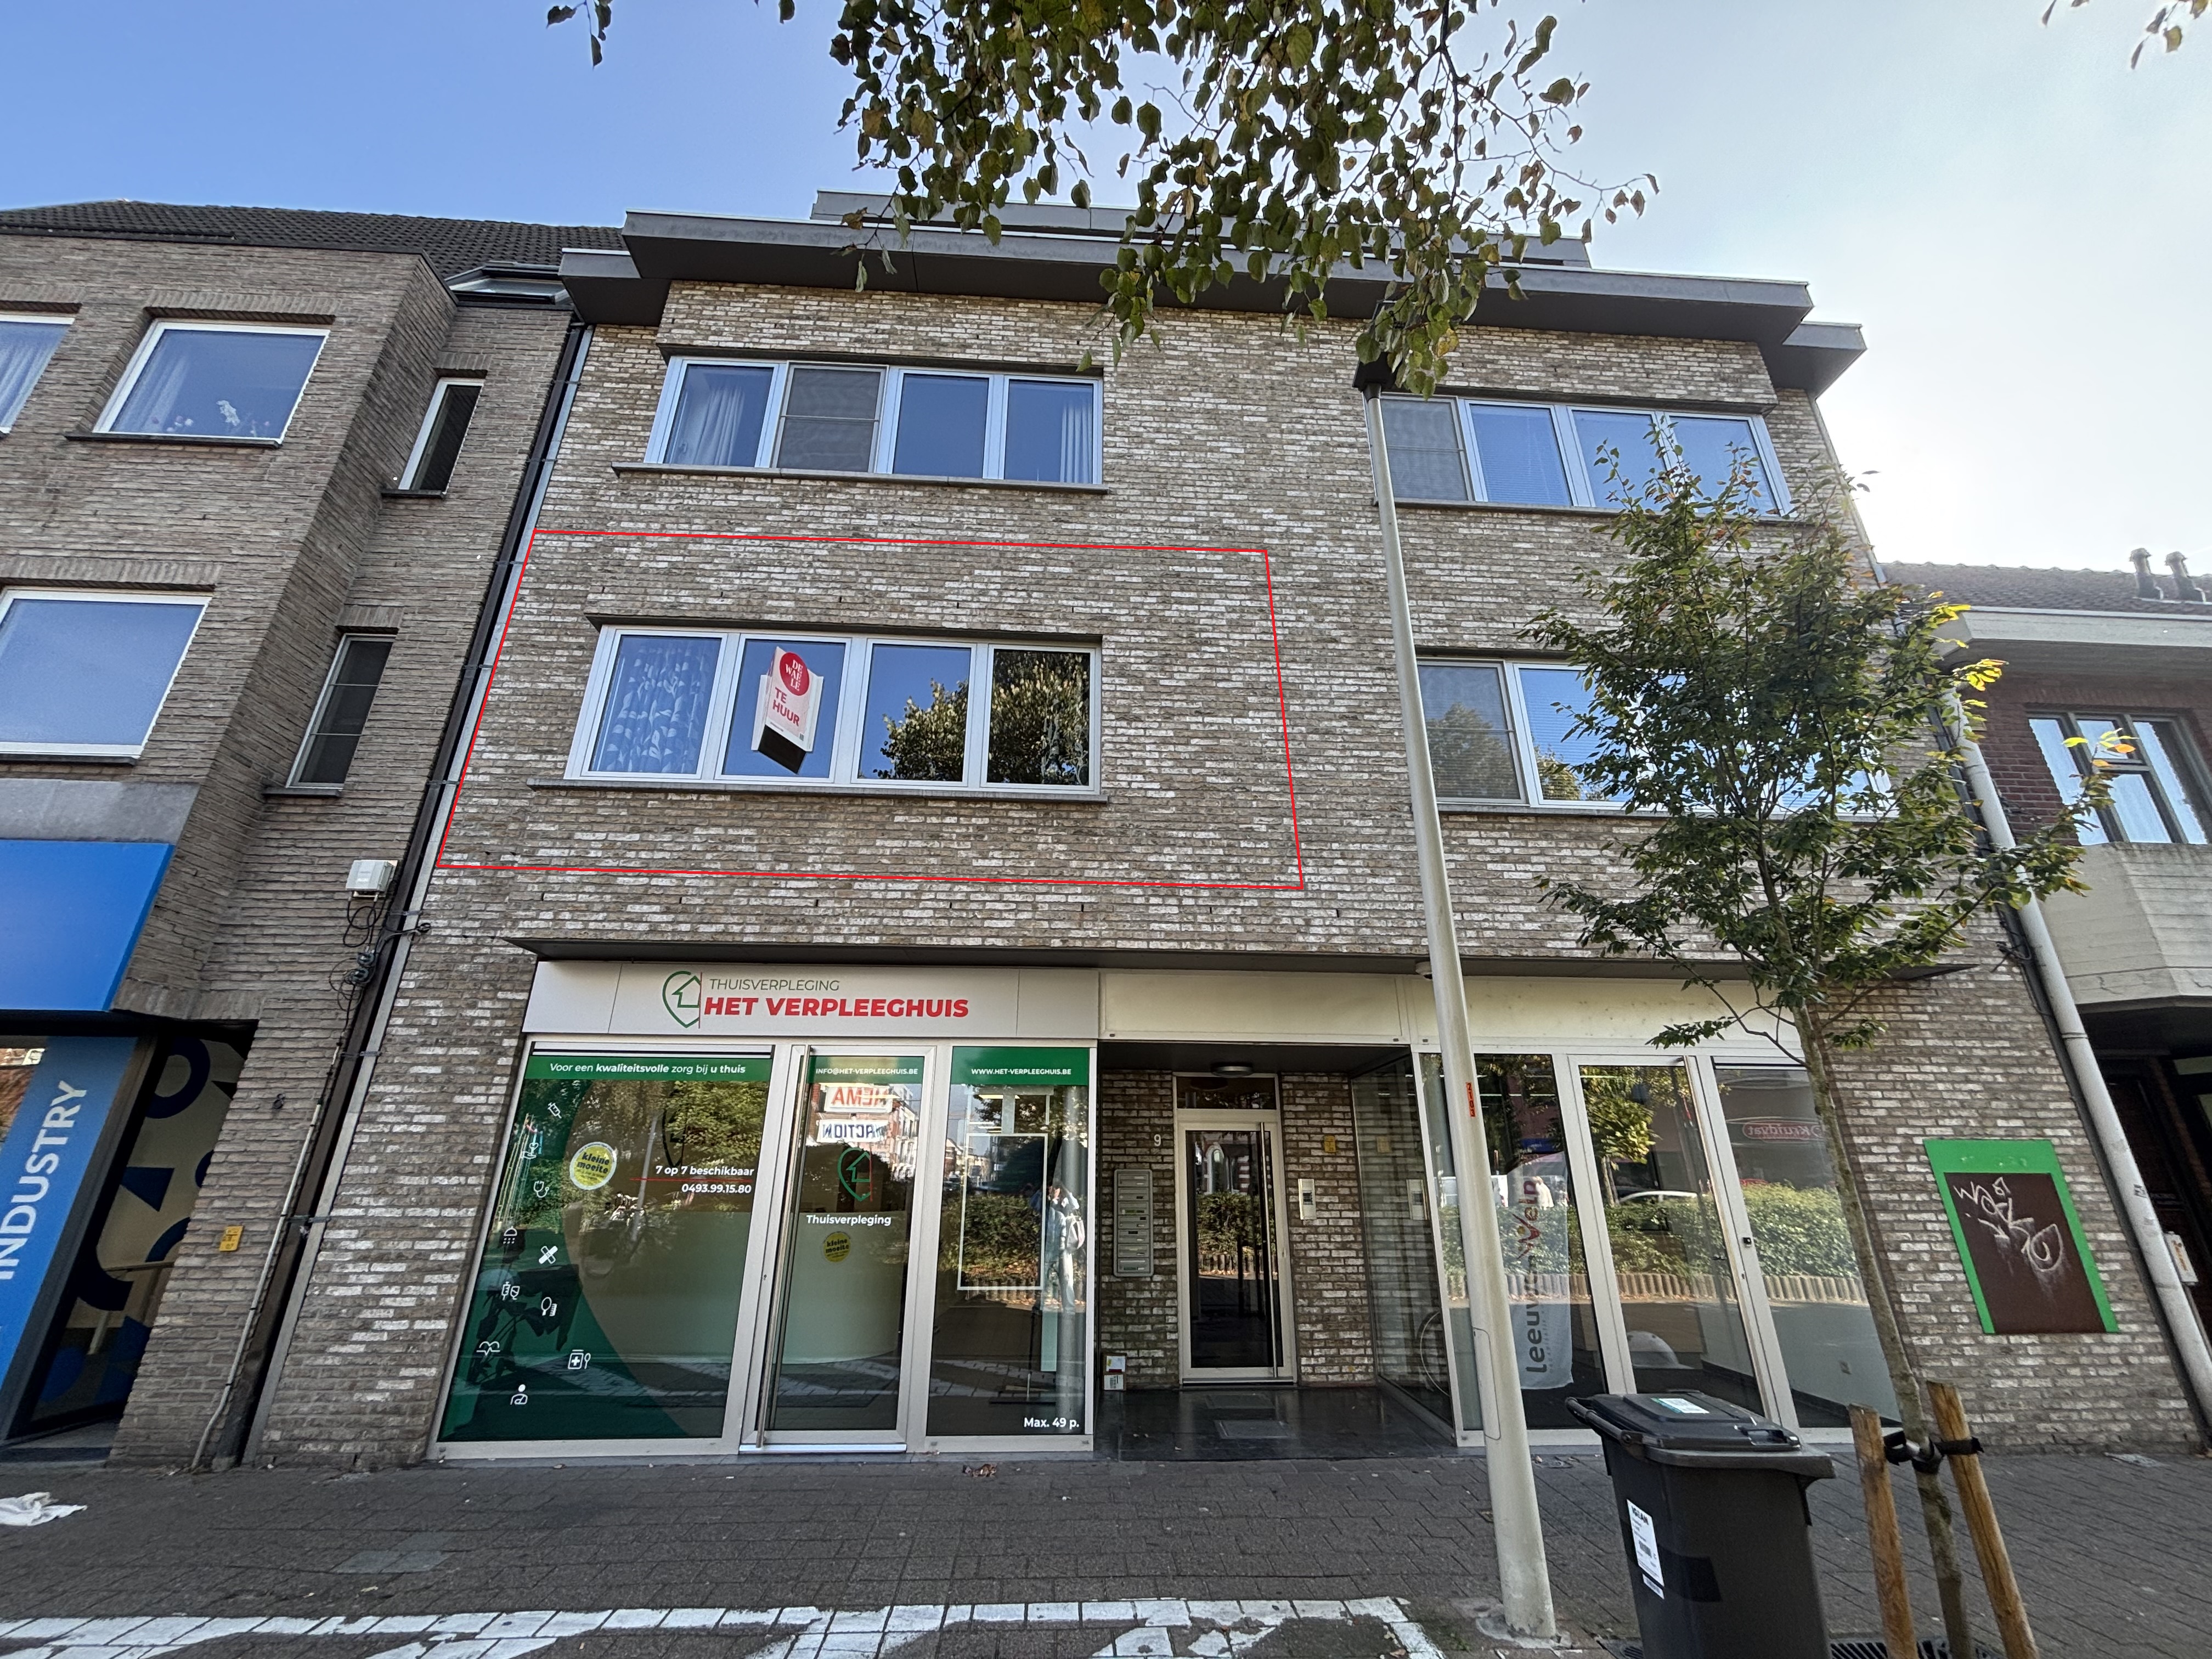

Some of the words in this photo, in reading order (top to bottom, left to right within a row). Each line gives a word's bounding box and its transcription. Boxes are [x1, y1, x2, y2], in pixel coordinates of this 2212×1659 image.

[792, 659, 803, 673] DE
[785, 664, 802, 683] WAE
[790, 678, 800, 691] LE
[775, 687, 787, 703] TE
[772, 699, 800, 727] HUUR
[710, 978, 840, 991] THUISVERPLEGING
[704, 997, 759, 1015] HET
[765, 997, 969, 1017] VERPLEEGHUIS
[550, 1063, 573, 1072] Voor
[596, 1063, 669, 1073] kwaliteitsvolle
[671, 1065, 693, 1075] zorg
[696, 1064, 708, 1075] bij
[710, 1065, 718, 1074] u
[720, 1064, 746, 1074] thuis
[815, 1068, 918, 1076] INFO@HET-VERPLEEGHUIS.BE
[971, 1068, 1072, 1076] WWW.HET-VERPLEEGHUIS.BE
[274, 1093, 285, 1109] 8
[1466, 1082, 1476, 1117] 2103
[1154, 1134, 1161, 1147] 9
[582, 1152, 610, 1165] kleine
[577, 1161, 608, 1174] moeite
[656, 1165, 663, 1174] 7
[664, 1167, 679, 1176] op
[681, 1166, 688, 1175] 7
[690, 1166, 755, 1176] beschikbaar
[681, 1183, 752, 1194] 0493.99.15.80
[806, 1214, 891, 1226] Thuisverpleging
[826, 1238, 848, 1248] kleine
[826, 1244, 849, 1254] moeite
[1024, 1417, 1050, 1427] Max.
[1052, 1417, 1066, 1427] 49
[1069, 1419, 1080, 1430] p.
